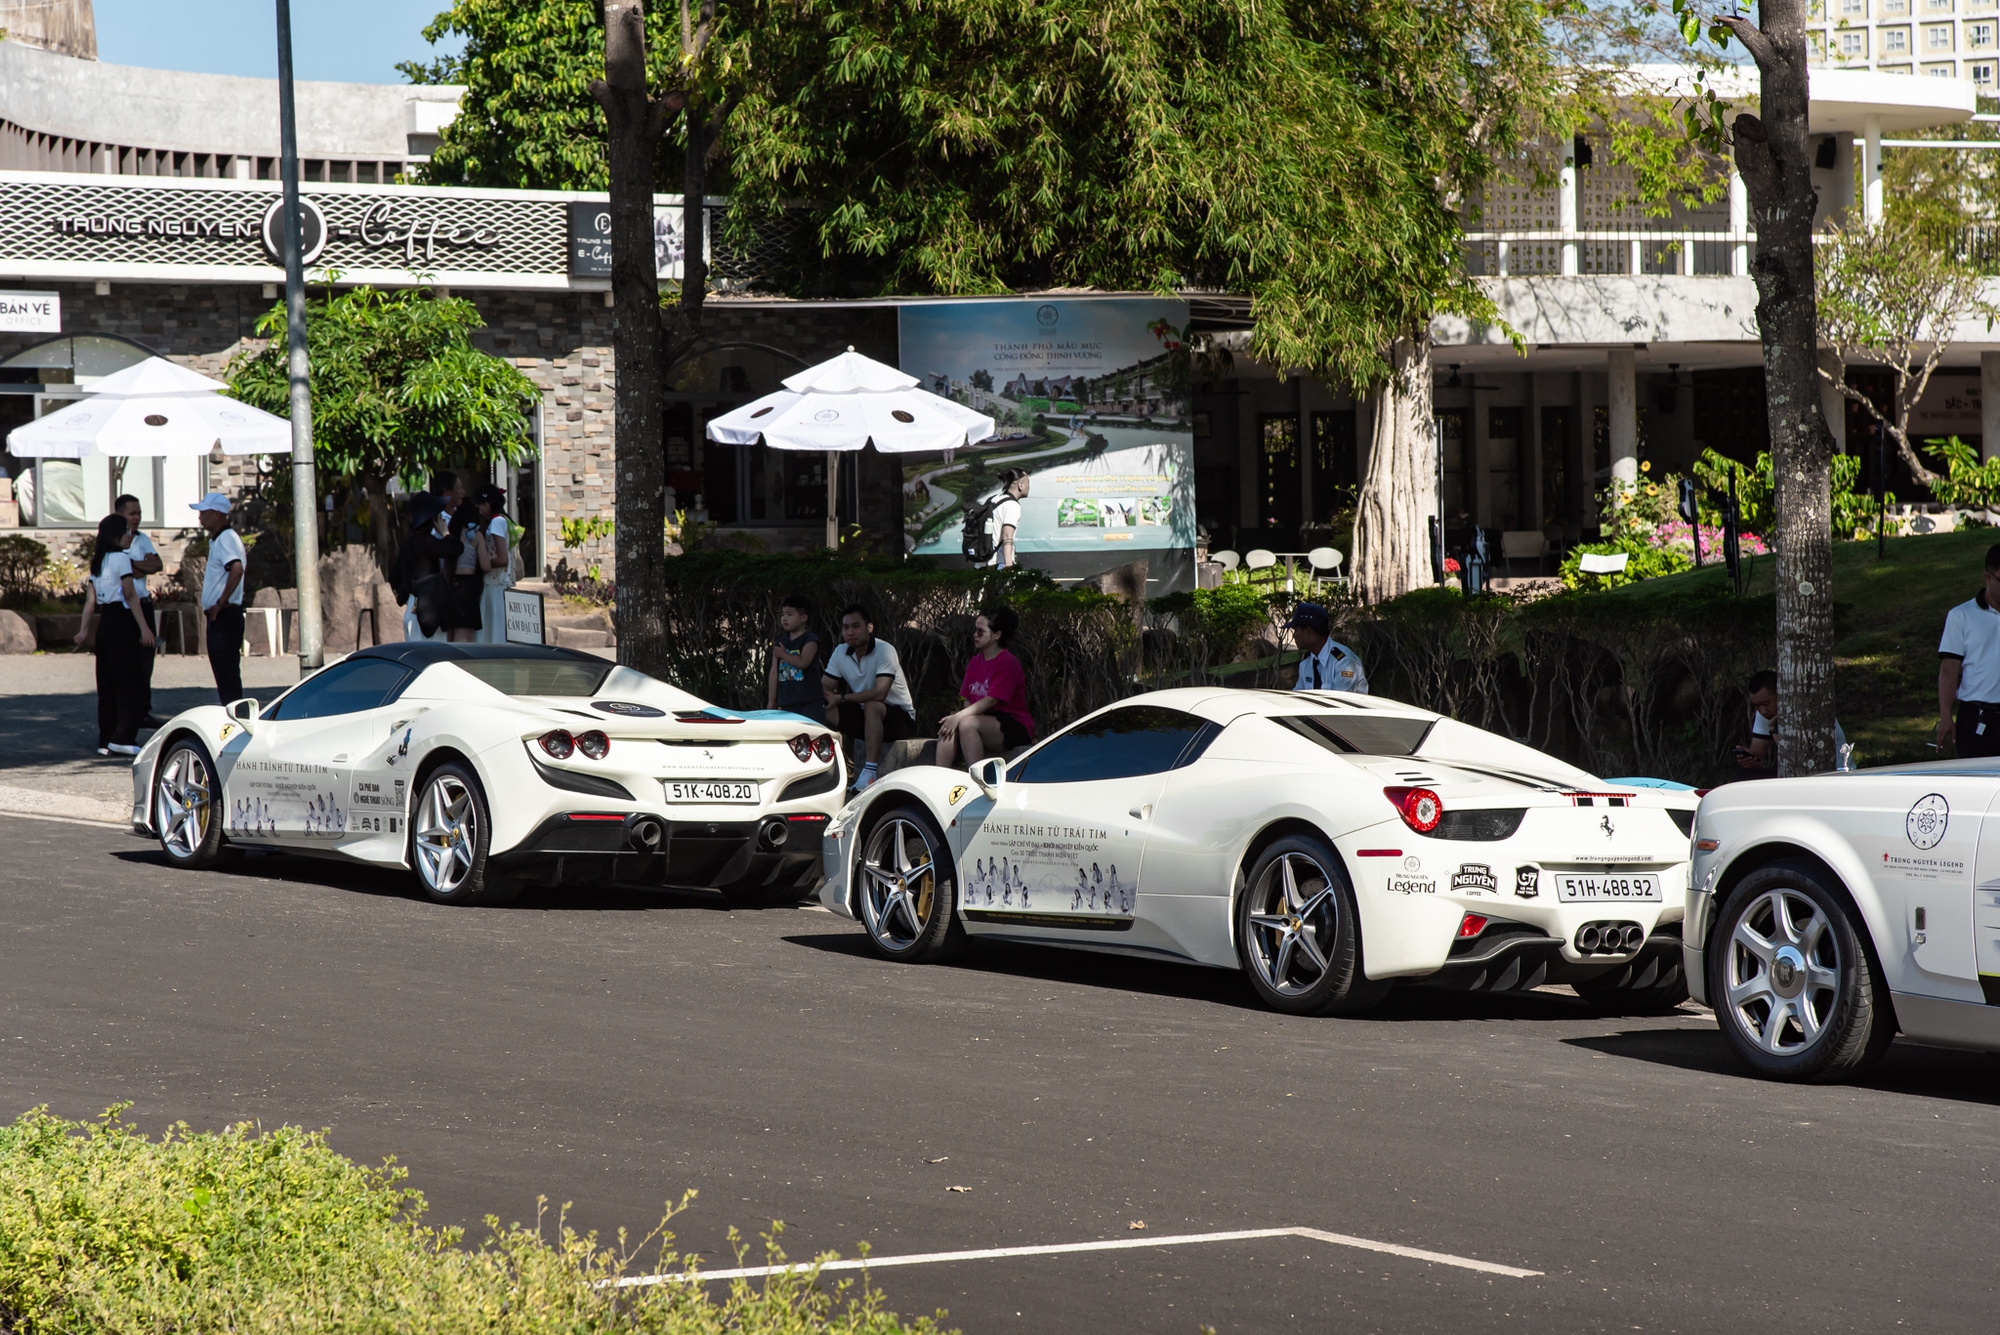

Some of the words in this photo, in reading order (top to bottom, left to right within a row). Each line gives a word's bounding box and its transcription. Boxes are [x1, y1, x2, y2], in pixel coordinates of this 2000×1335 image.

[57, 217, 141, 234] TRUNG
[361, 200, 505, 260] Coffee
[577, 237, 601, 245] TRUNG
[0, 299, 28, 315] BÁN
[32, 300, 51, 316] VÉ
[6, 316, 42, 326] OFFICE
[994, 341, 1028, 351] THÀNH
[1032, 340, 1053, 350] PHỐ
[994, 351, 1018, 361] CỘNG
[1046, 352, 1072, 360] THỊNH
[1073, 351, 1102, 360] VƯỢNG
[508, 601, 522, 614] KHU
[523, 602, 537, 618] VỰC
[532, 622, 541, 634] XE
[236, 760, 257, 771] HÀNH
[260, 761, 283, 772] TRÌNH
[314, 764, 328, 774] TIM
[672, 784, 752, 799] 51K-408.20
[983, 822, 1010, 835] HÀNH
[1013, 823, 1044, 837] TRÌNH
[1047, 825, 1061, 838] TỪ
[1063, 825, 1085, 839] TRÁI
[1089, 828, 1108, 840] TIM
[1890, 856, 1911, 864] TRUNG
[1912, 858, 1938, 866] NGUYÊN
[1939, 860, 1964, 868] LEGEND
[1463, 866, 1487, 875] TRUNG
[1387, 877, 1436, 896] Legend
[1454, 873, 1495, 889] NGUYÊN
[1517, 872, 1538, 887] G7
[1565, 879, 1653, 897] 51H-488.92
